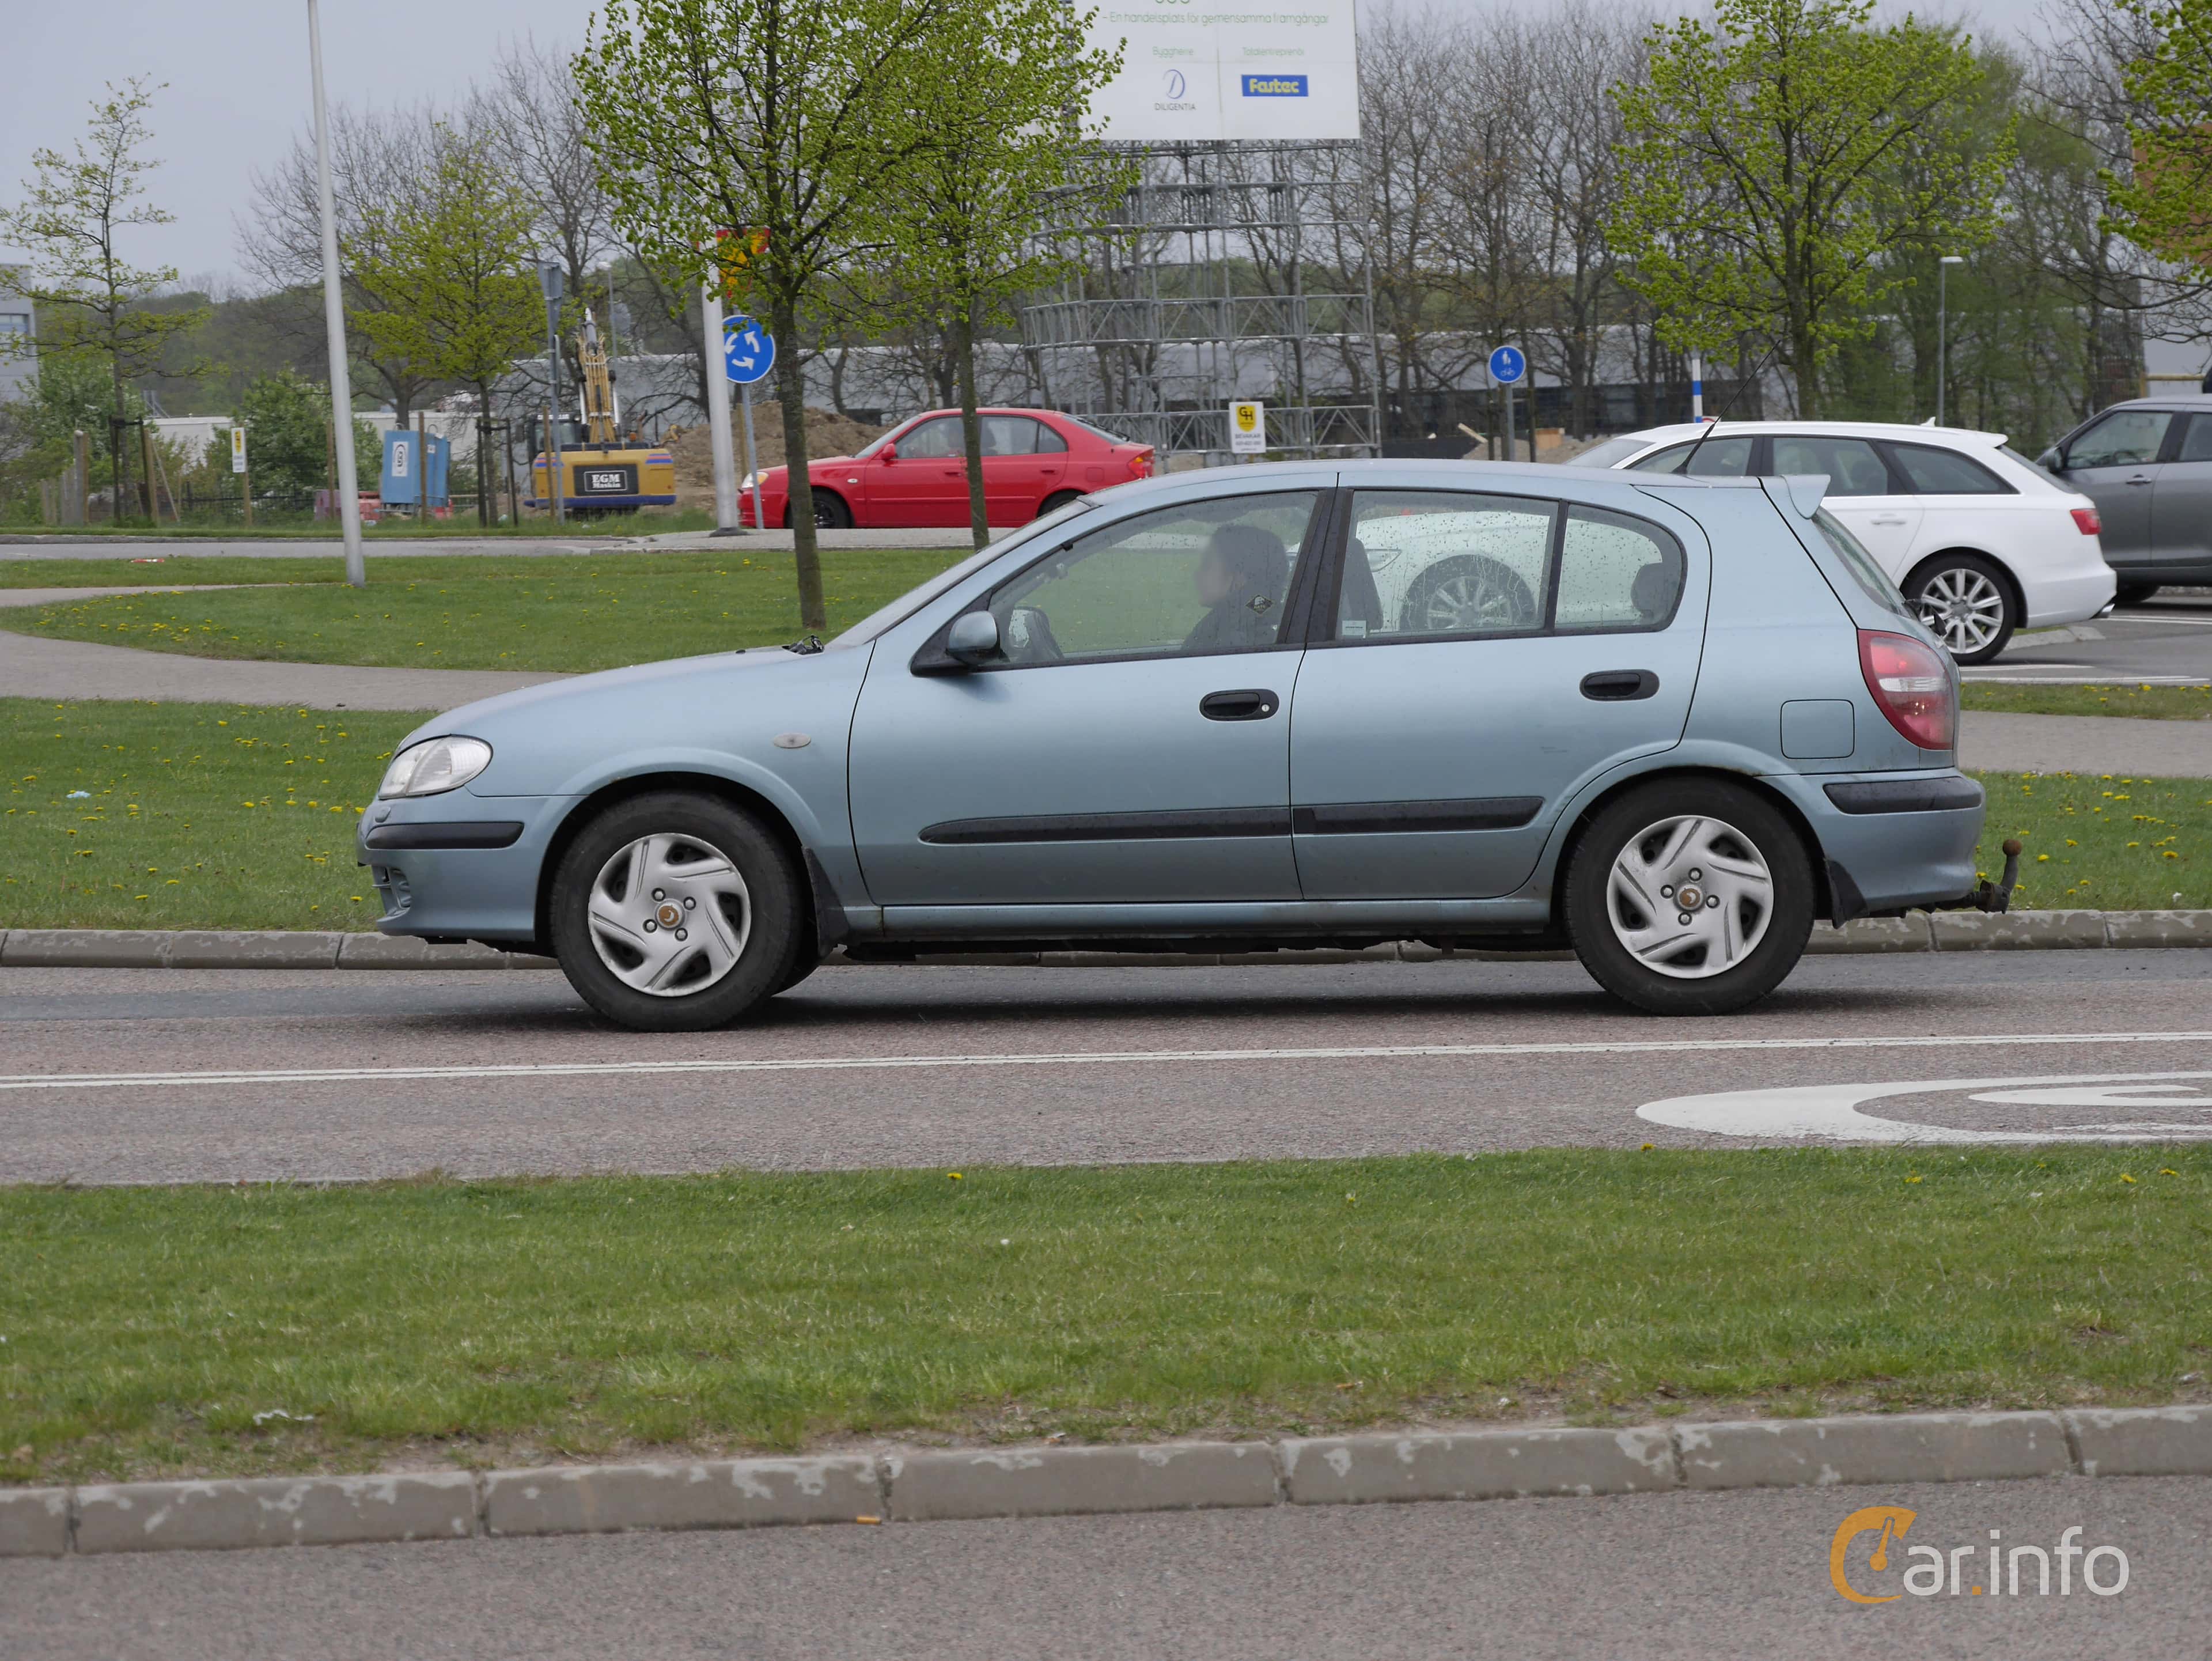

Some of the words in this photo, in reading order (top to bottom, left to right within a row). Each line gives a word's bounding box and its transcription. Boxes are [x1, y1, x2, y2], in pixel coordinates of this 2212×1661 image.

[1111, 12, 1122, 22] En
[1124, 11, 1185, 25] handelsplats
[1202, 13, 1271, 26] gemensamma
[1249, 78, 1300, 93] Fastec
[1154, 103, 1196, 111] DILIGENTIA
[592, 474, 620, 483] EGM
